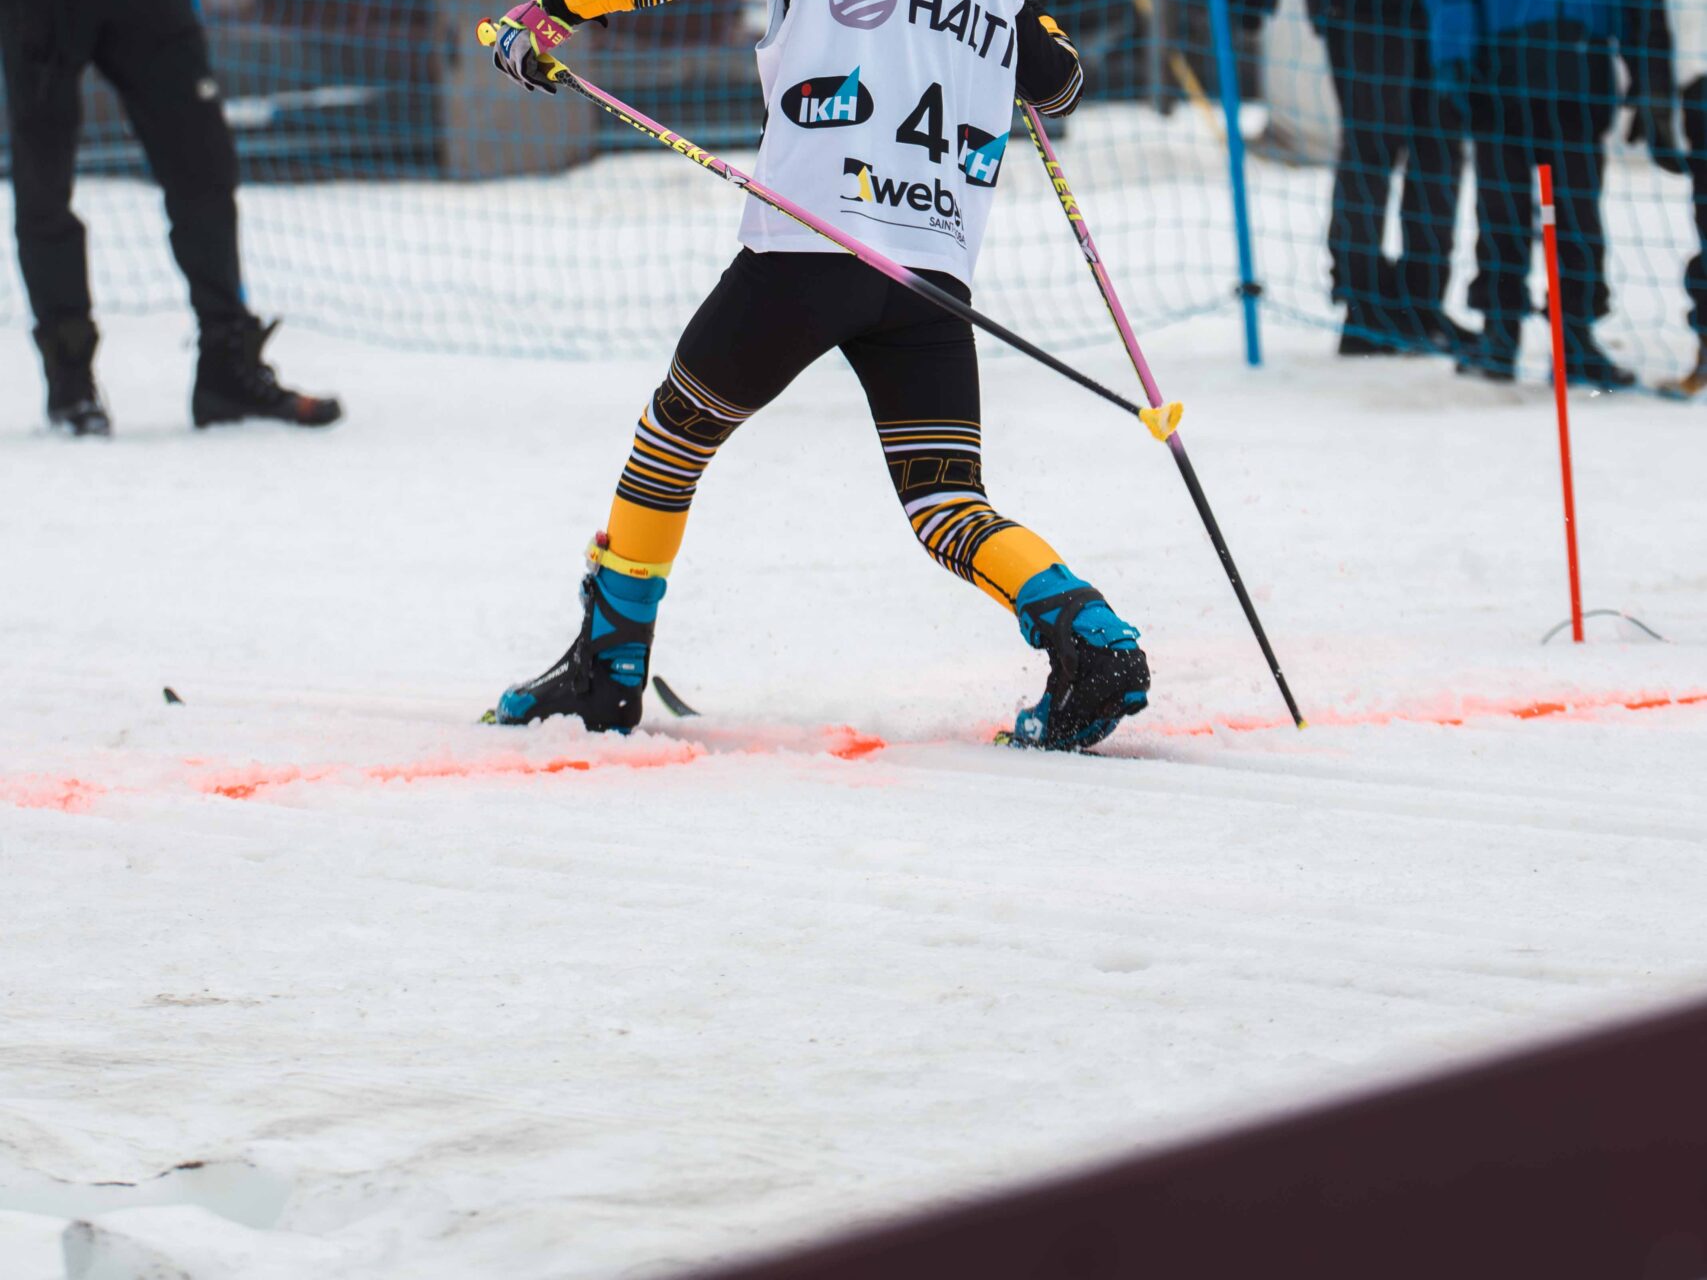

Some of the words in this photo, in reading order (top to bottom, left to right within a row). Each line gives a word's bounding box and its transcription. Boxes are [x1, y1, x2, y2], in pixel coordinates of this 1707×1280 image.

[535, 18, 565, 47] EKI
[896, 81, 950, 165] 4
[658, 129, 718, 168] LEKI
[1045, 161, 1084, 222] LEKI
